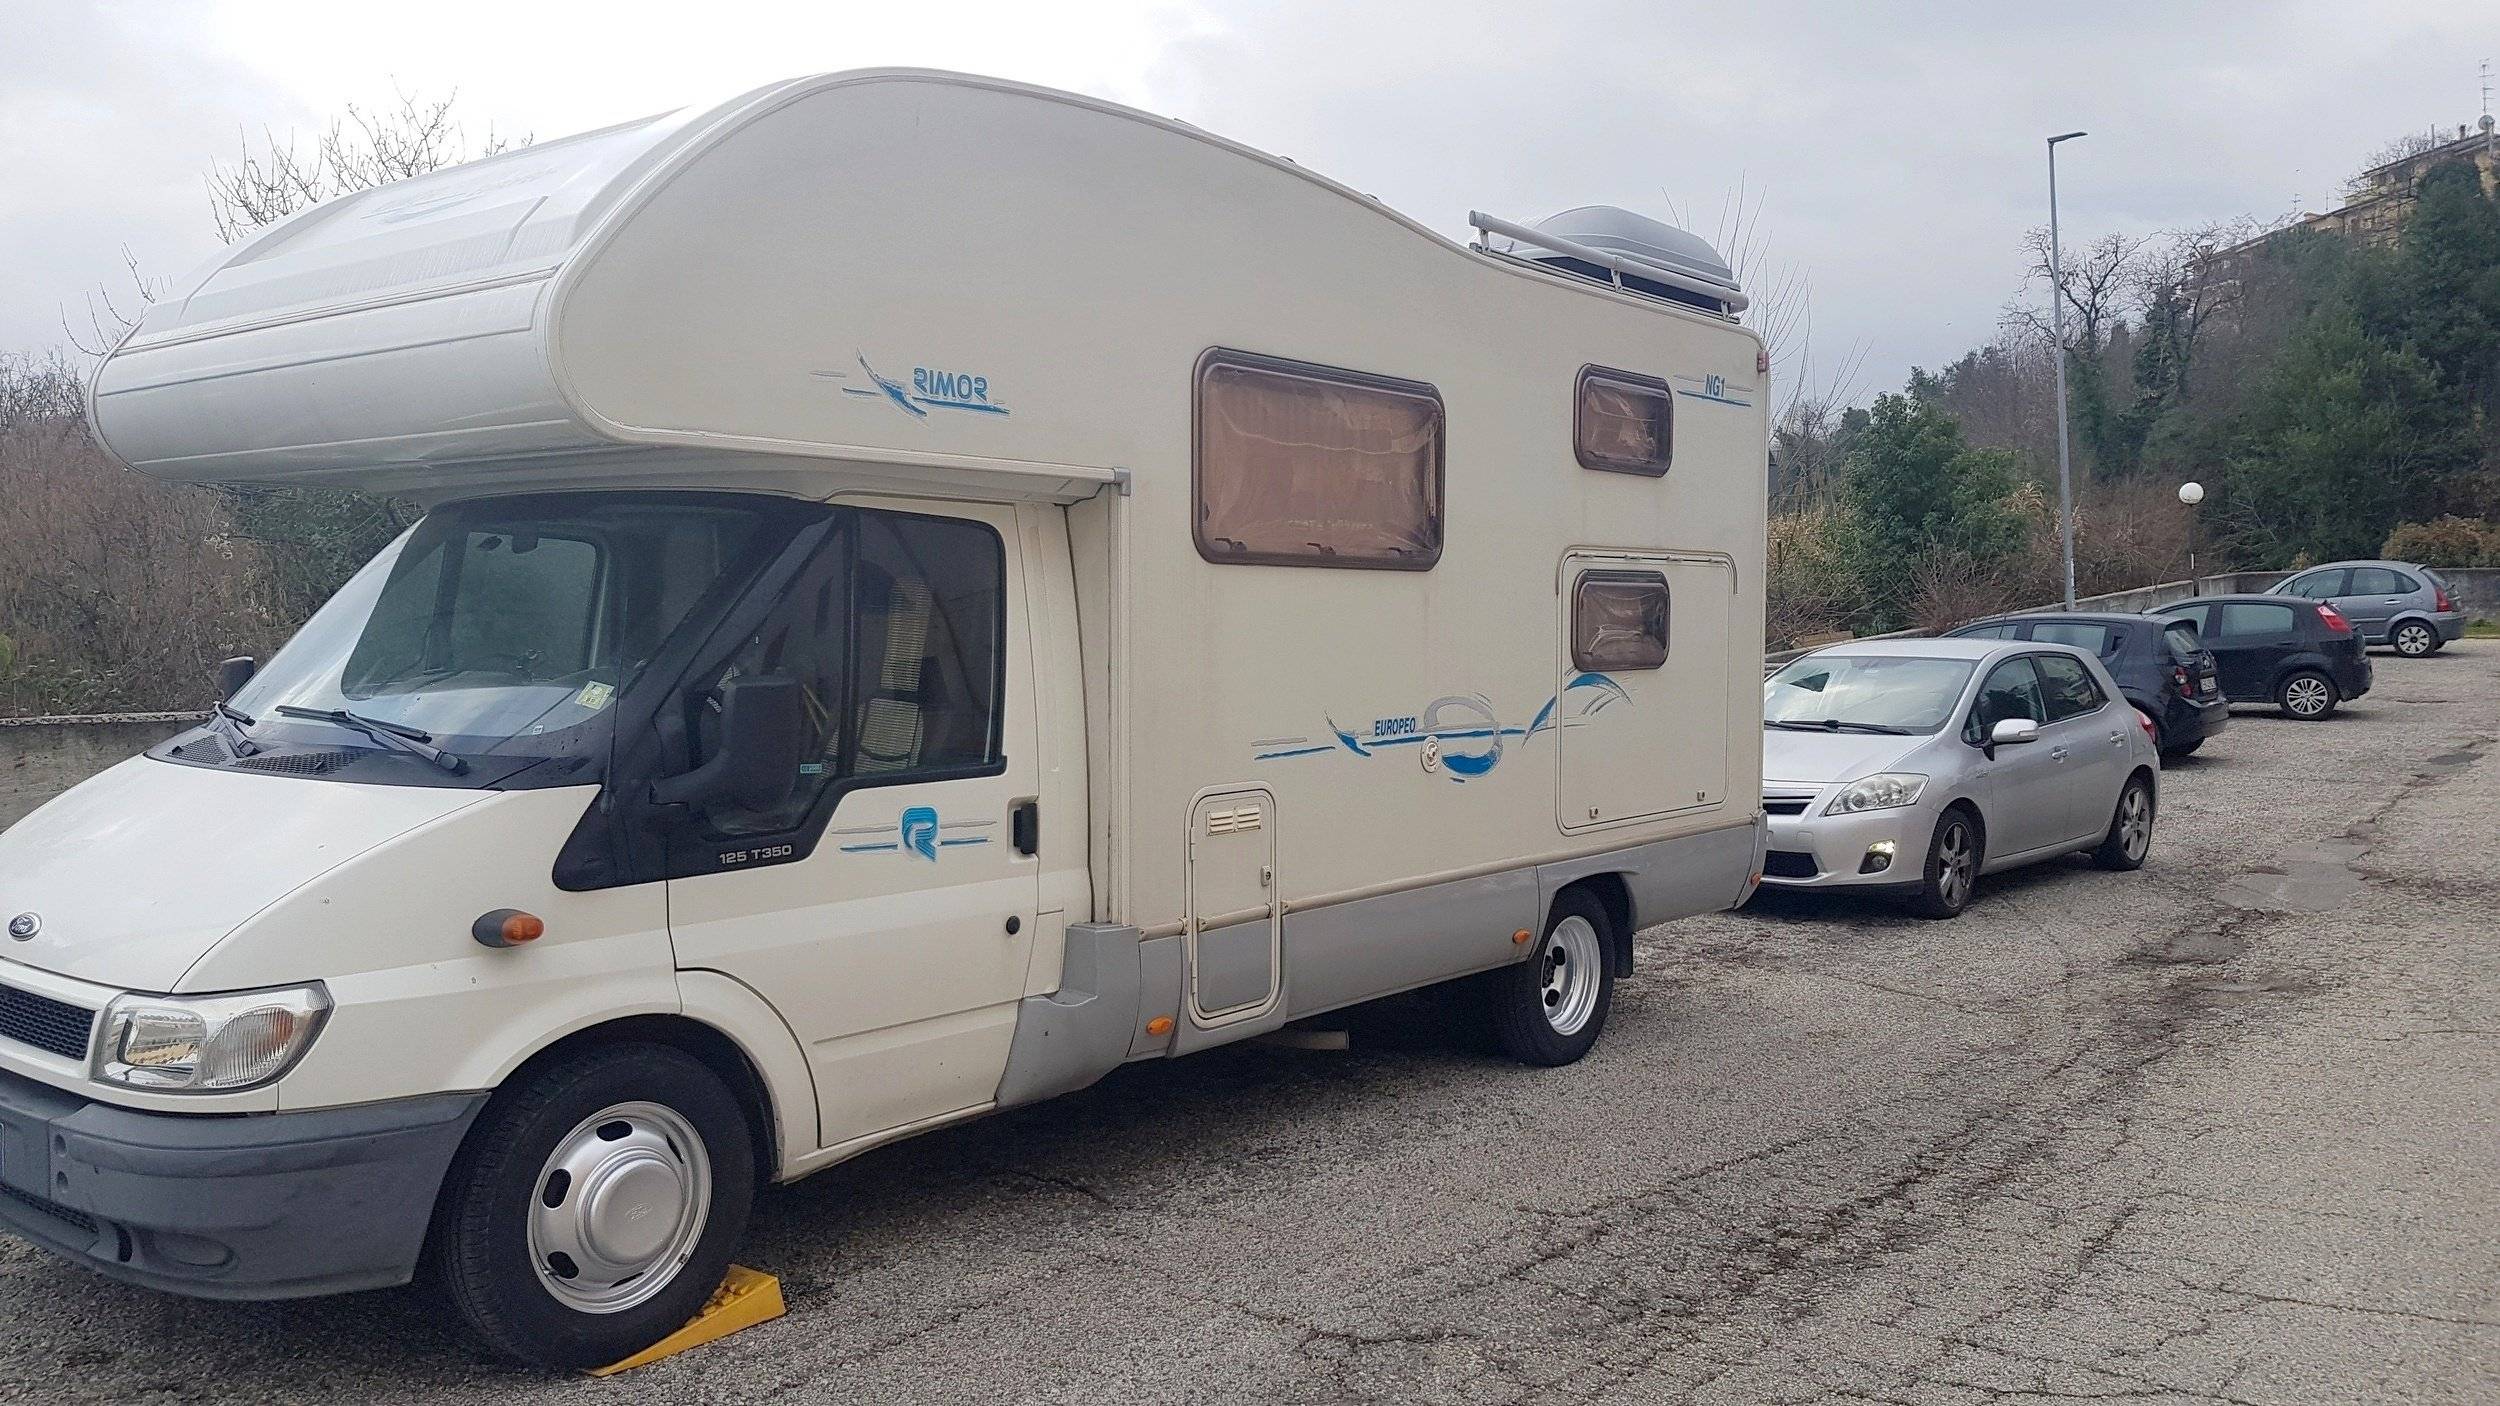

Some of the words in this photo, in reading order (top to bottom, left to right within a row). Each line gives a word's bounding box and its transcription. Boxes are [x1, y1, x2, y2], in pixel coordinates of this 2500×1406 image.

[913, 367, 989, 403] RIMOR
[1705, 374, 1726, 398] NG1
[1375, 717, 1416, 736] EUROPEO
[719, 851, 747, 864] 125
[751, 844, 792, 860] T350
